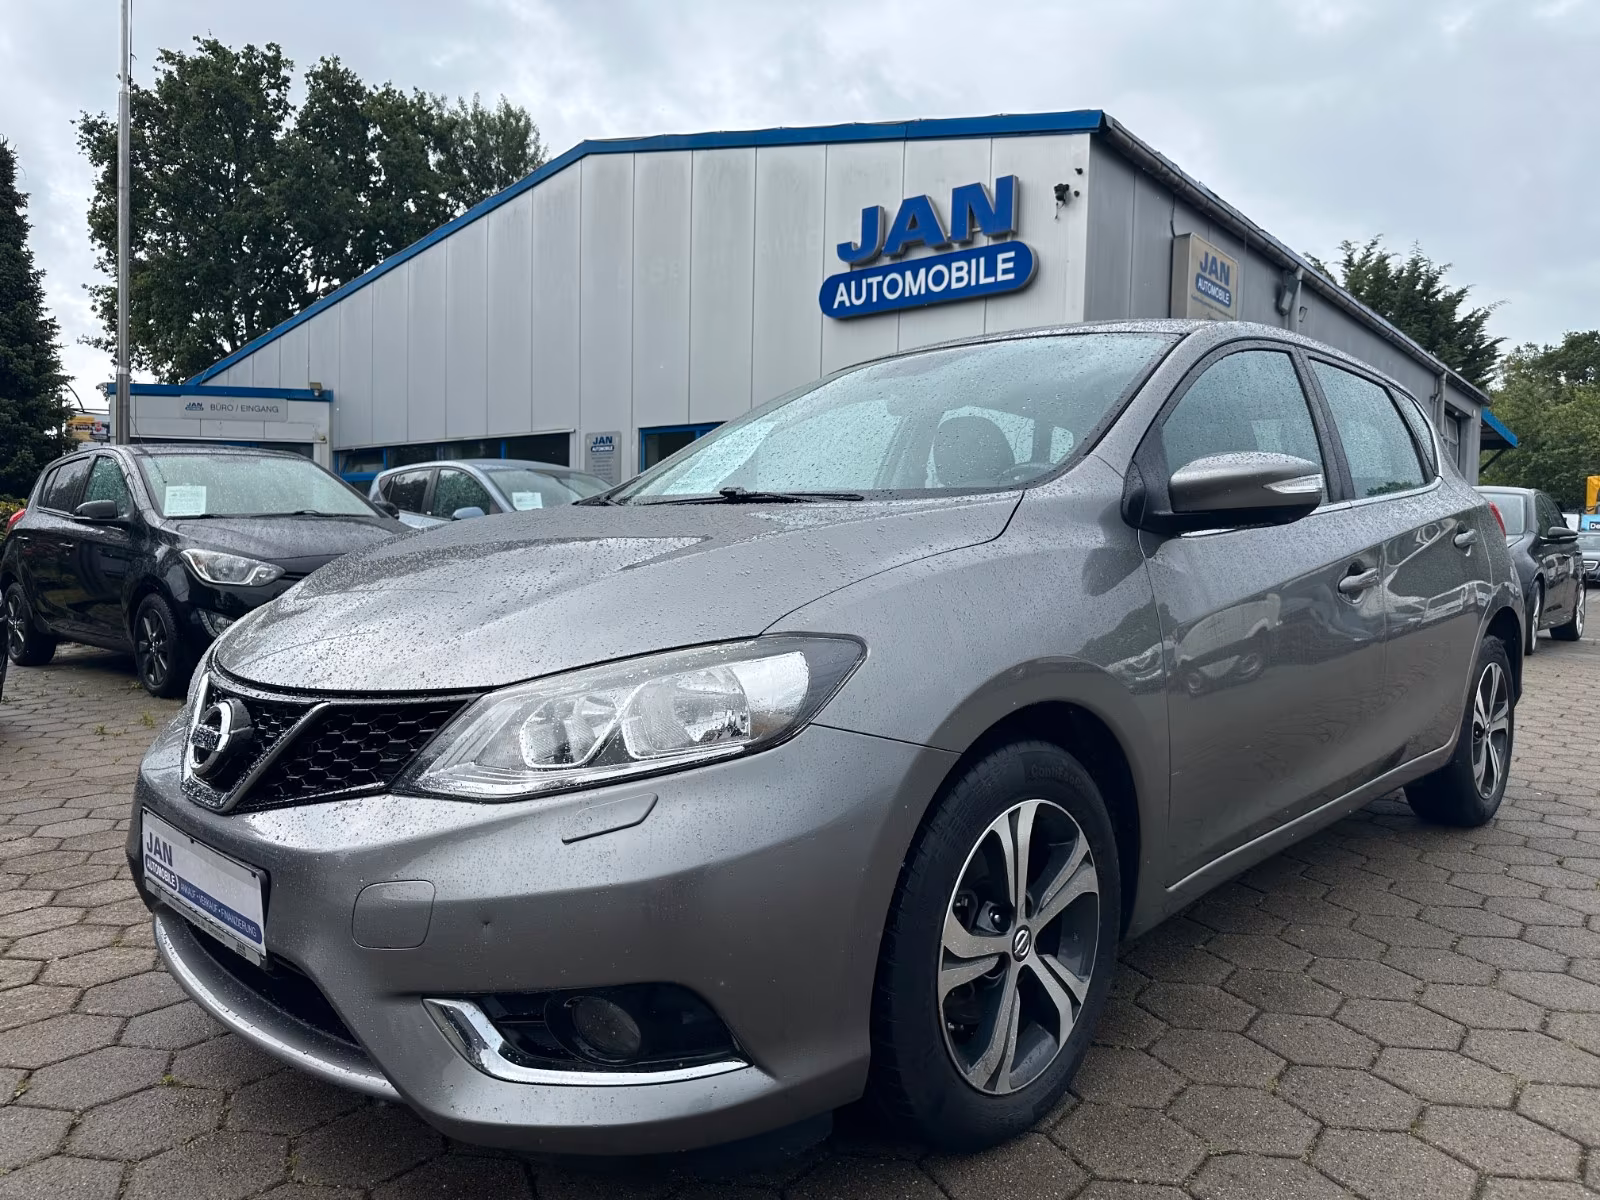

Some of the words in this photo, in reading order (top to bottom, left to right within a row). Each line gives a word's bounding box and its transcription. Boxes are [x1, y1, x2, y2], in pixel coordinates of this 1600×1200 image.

[837, 174, 1017, 264] JAN
[833, 251, 1016, 309] AUTOMOBILE
[1200, 251, 1231, 286] JAN
[1198, 277, 1230, 305] AUTOMOBILE
[210, 403, 234, 412] BÜRO
[240, 404, 279, 413] EINGANG
[592, 436, 613, 445] JAN
[146, 831, 173, 867] JAN
[147, 858, 176, 887] AUTOMOBILE
